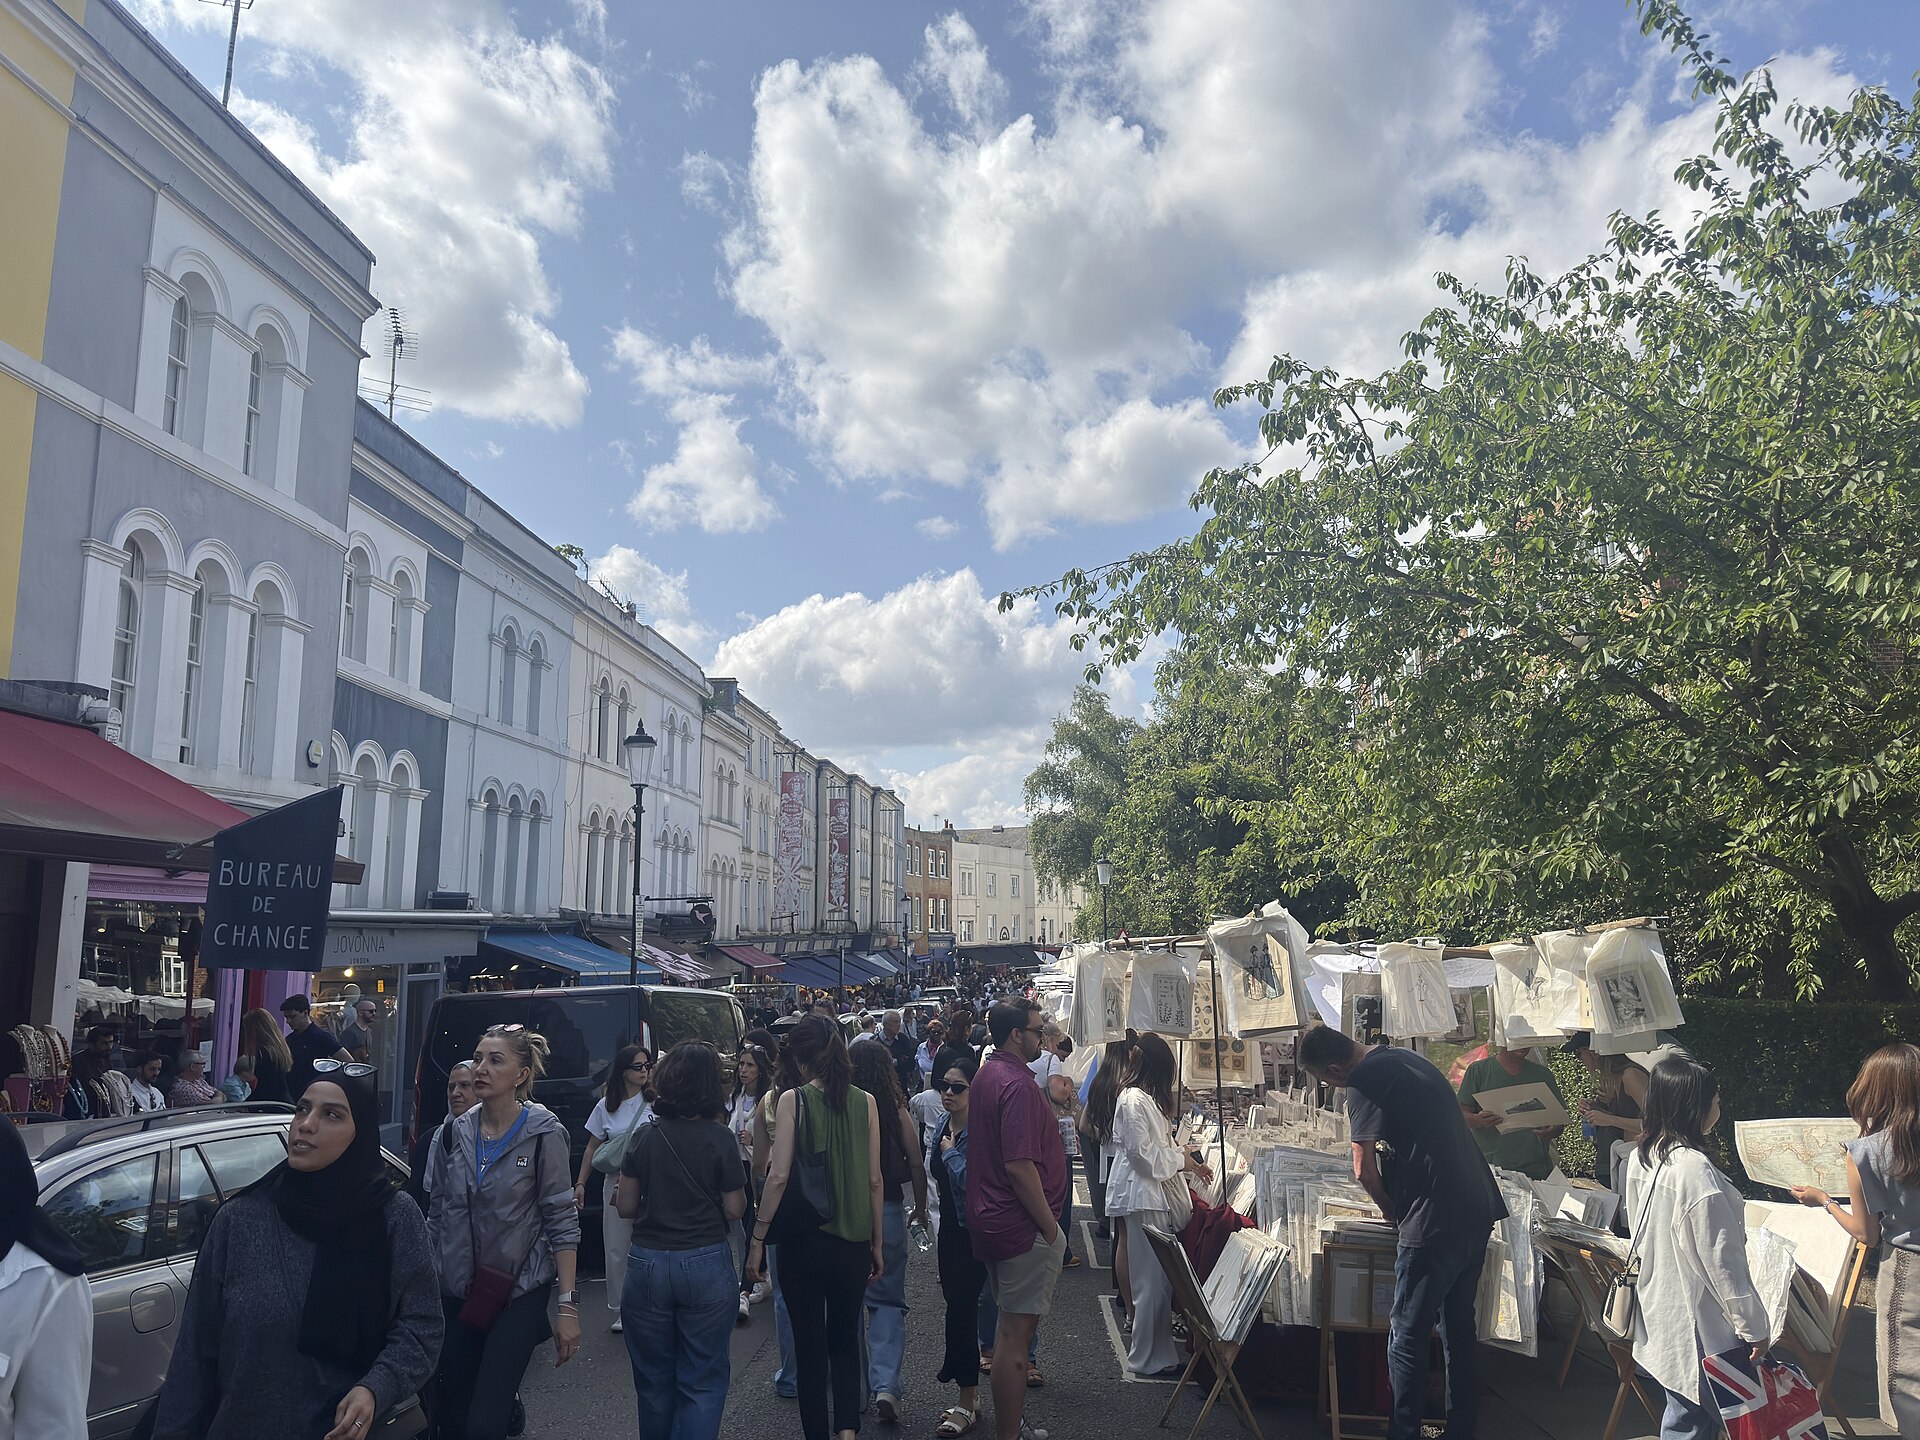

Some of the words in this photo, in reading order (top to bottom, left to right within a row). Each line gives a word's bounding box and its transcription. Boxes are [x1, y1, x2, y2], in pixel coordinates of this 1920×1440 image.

[218, 859, 322, 890] BUREAU
[251, 895, 276, 914] DE
[213, 923, 312, 951] CHANGE
[333, 935, 386, 954] JOVONNA
